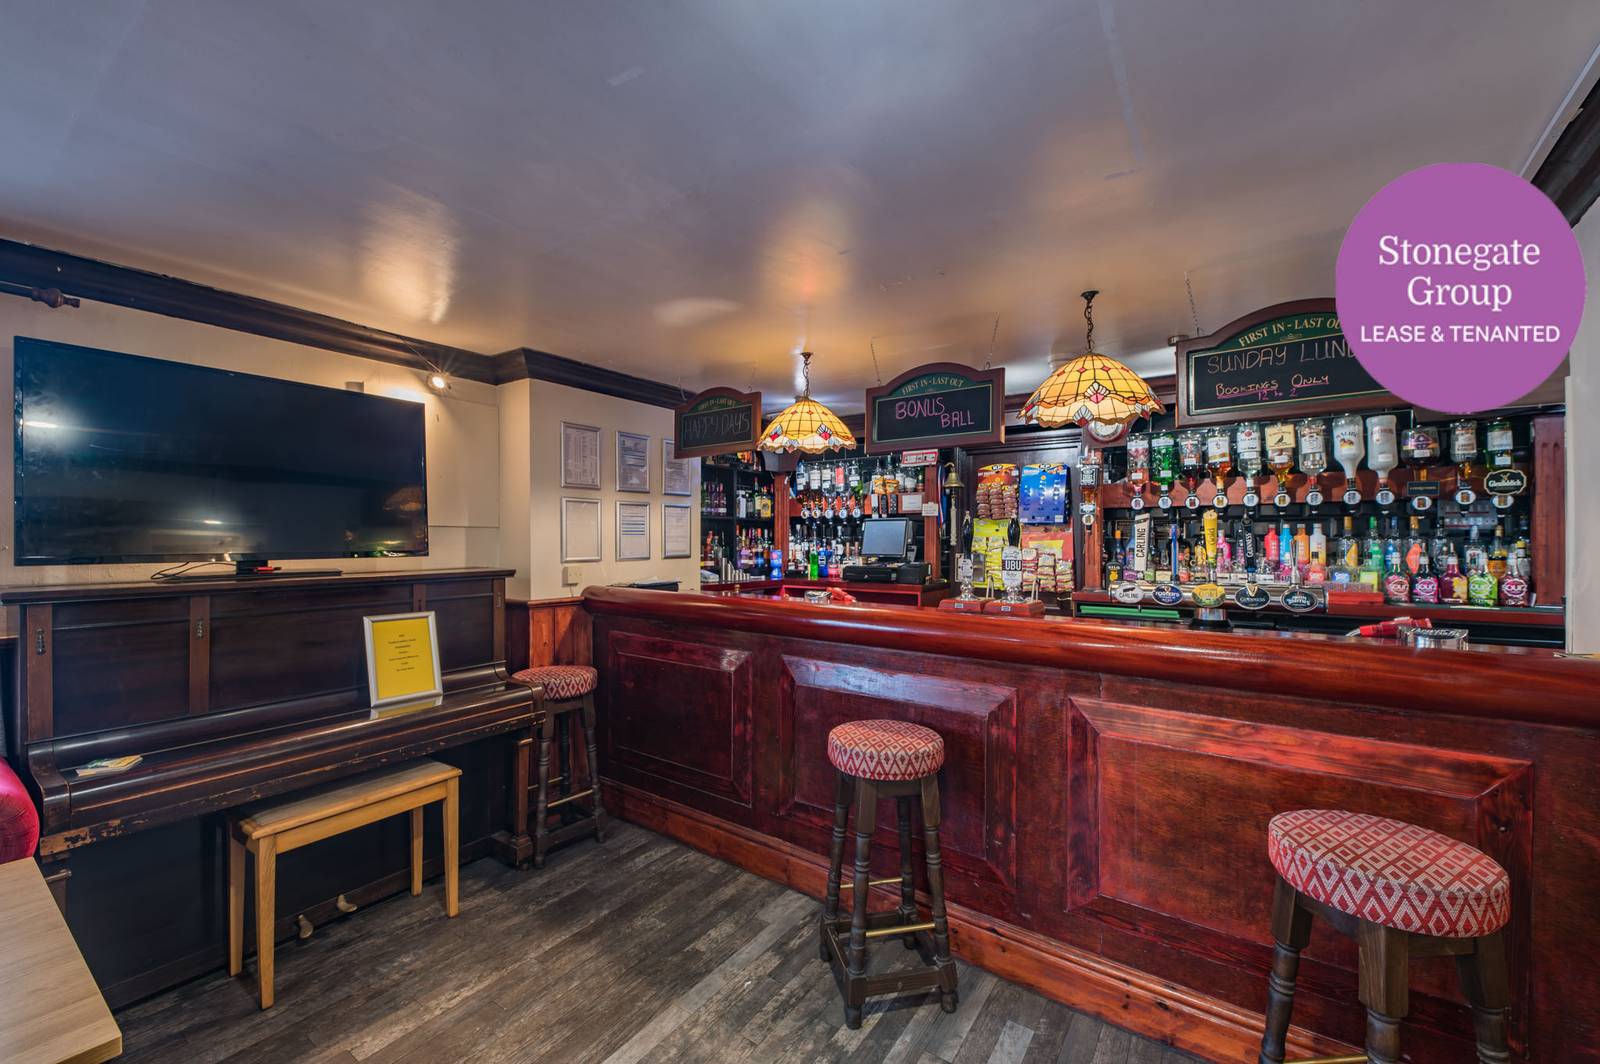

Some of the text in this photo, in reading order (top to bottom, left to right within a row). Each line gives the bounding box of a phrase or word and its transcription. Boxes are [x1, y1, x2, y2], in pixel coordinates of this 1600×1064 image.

[1239, 327, 1268, 347] FIRST
[1272, 321, 1285, 334] IN
[1294, 317, 1324, 330] LAST
[1207, 346, 1287, 374] SUNDAY
[902, 382, 919, 395] FIRST
[932, 376, 949, 385] LAST
[950, 377, 964, 387] OUT
[895, 397, 945, 420] BONUS
[941, 410, 975, 428] BALL
[720, 412, 751, 434] DAYS
[1136, 527, 1146, 558] CARLING
[1004, 560, 1022, 571] UBU
